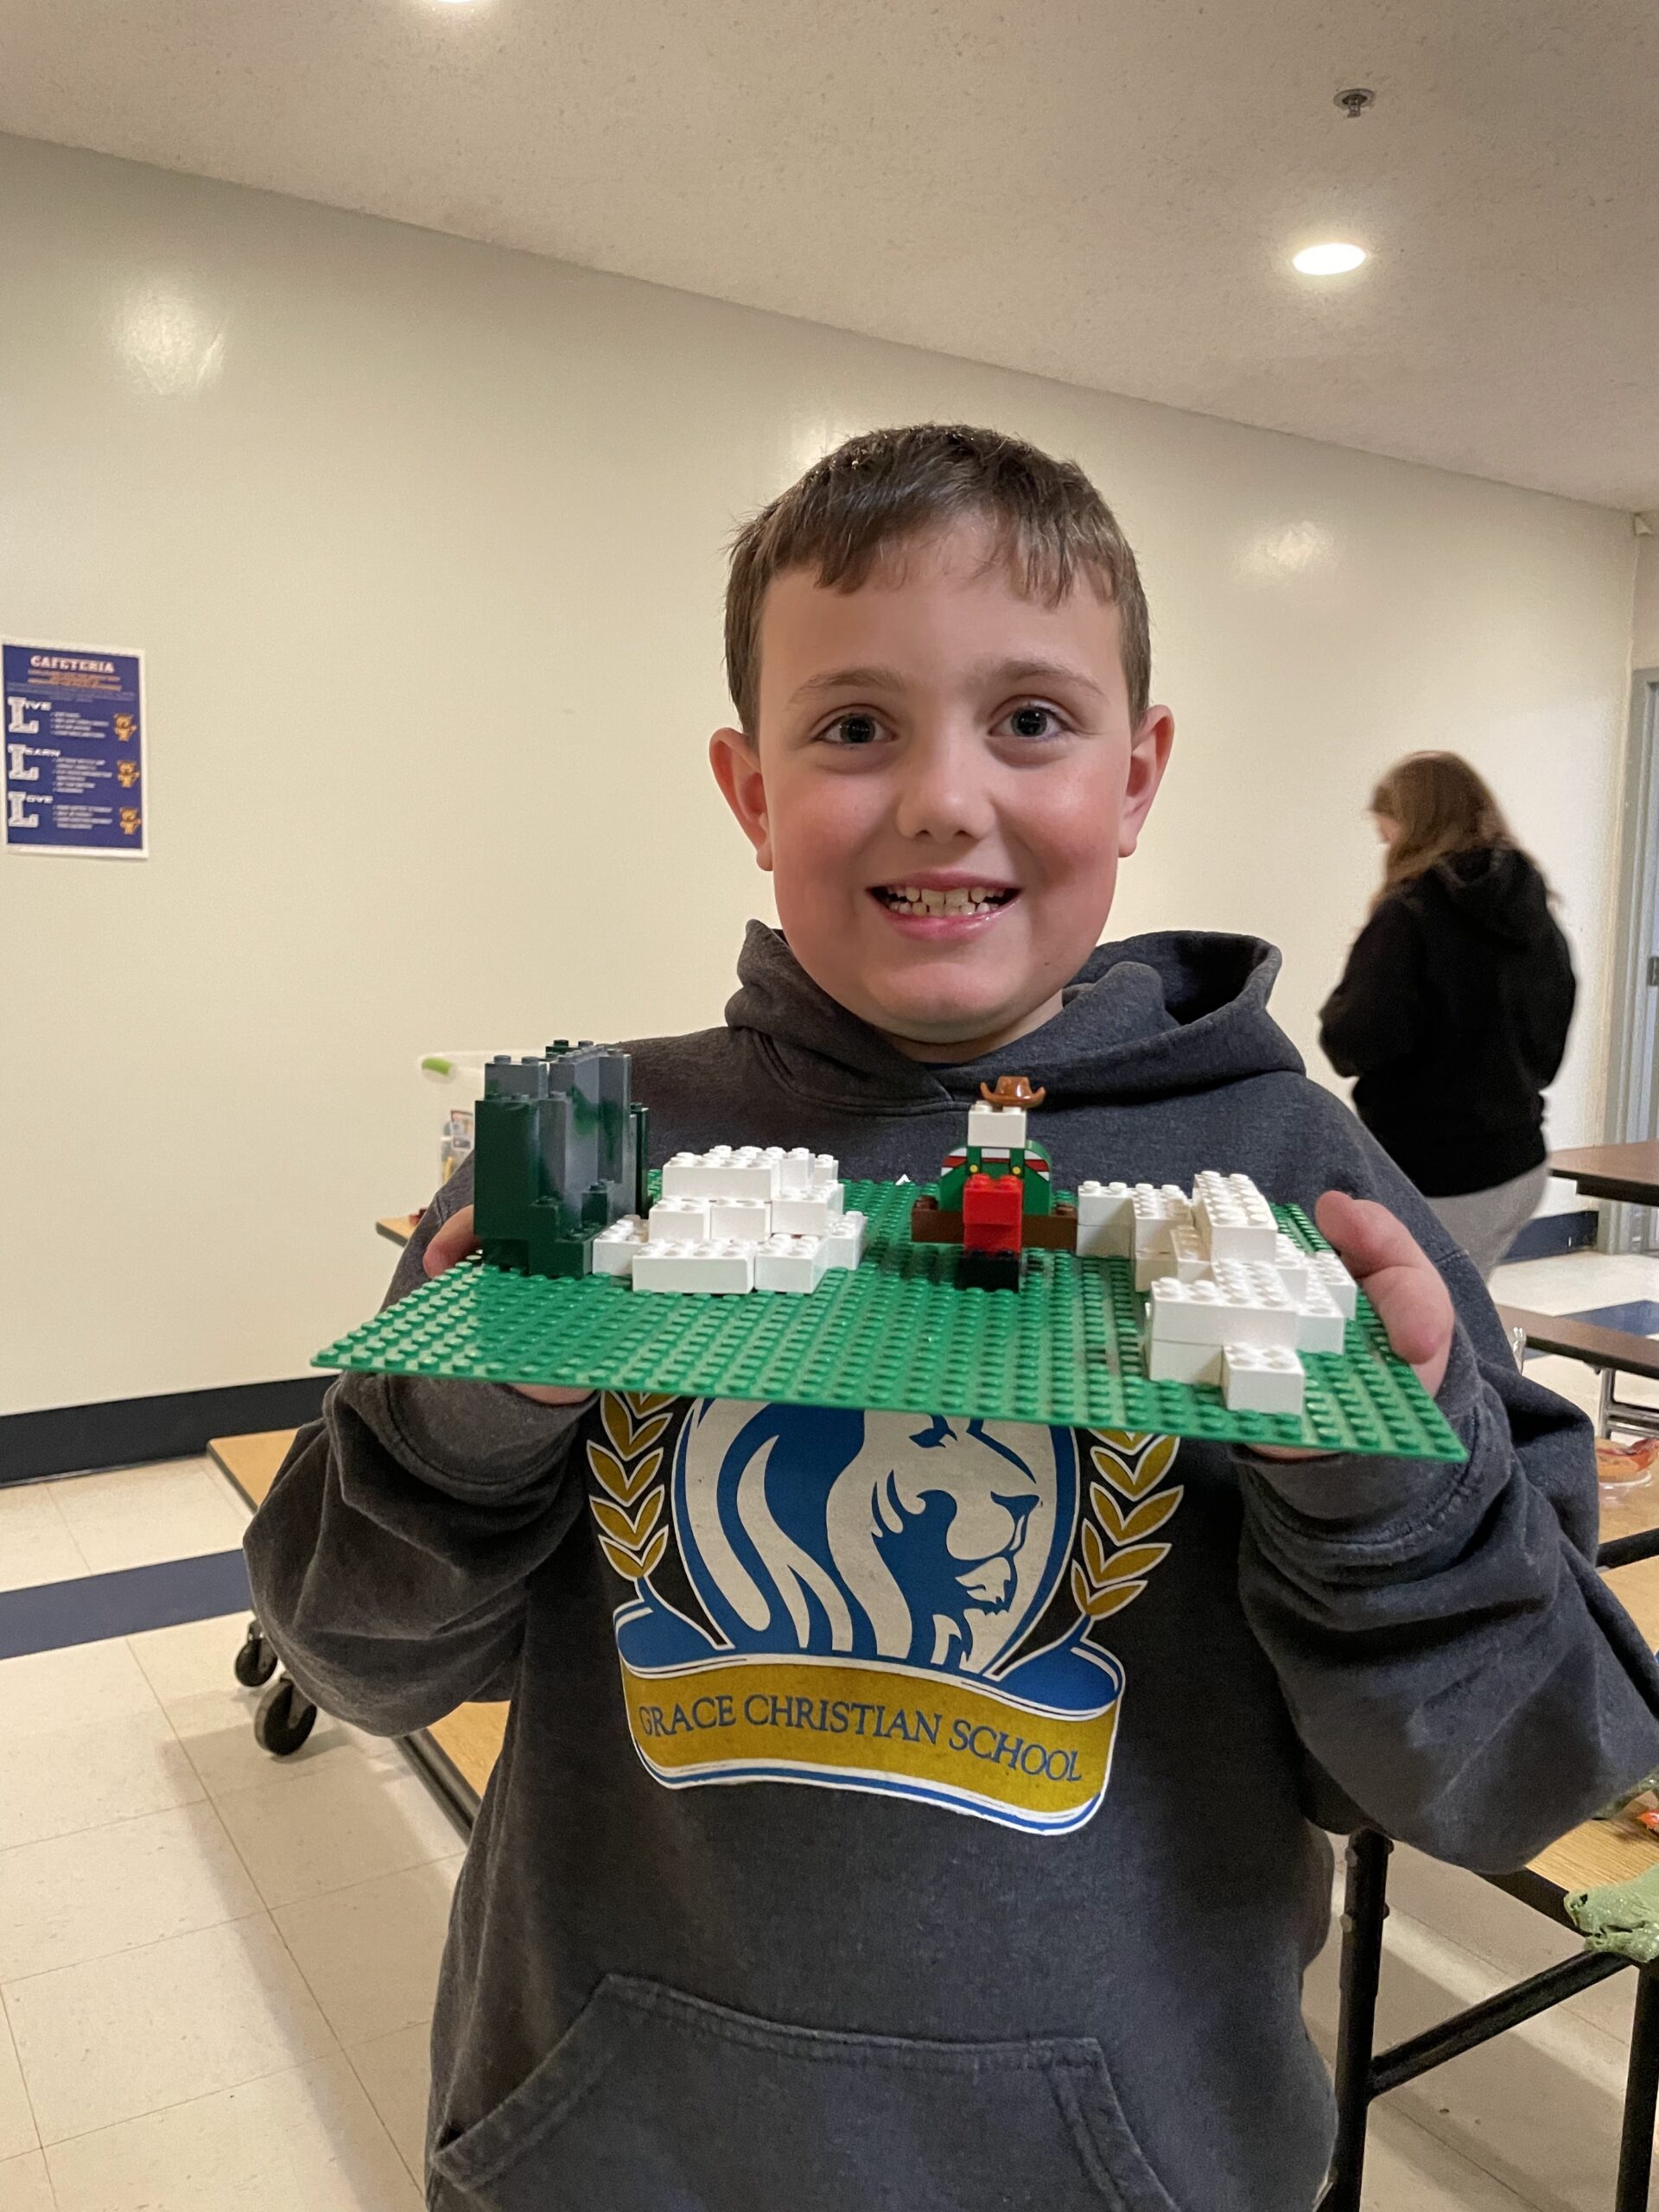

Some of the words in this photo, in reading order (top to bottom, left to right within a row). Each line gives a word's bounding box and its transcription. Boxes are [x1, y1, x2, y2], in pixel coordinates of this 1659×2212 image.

[30, 655, 115, 673] CAFETERIA
[639, 1694, 736, 1738] GRACE
[744, 1694, 942, 1745] CHRISTIAN
[948, 1719, 1083, 1783] SCHOOL
